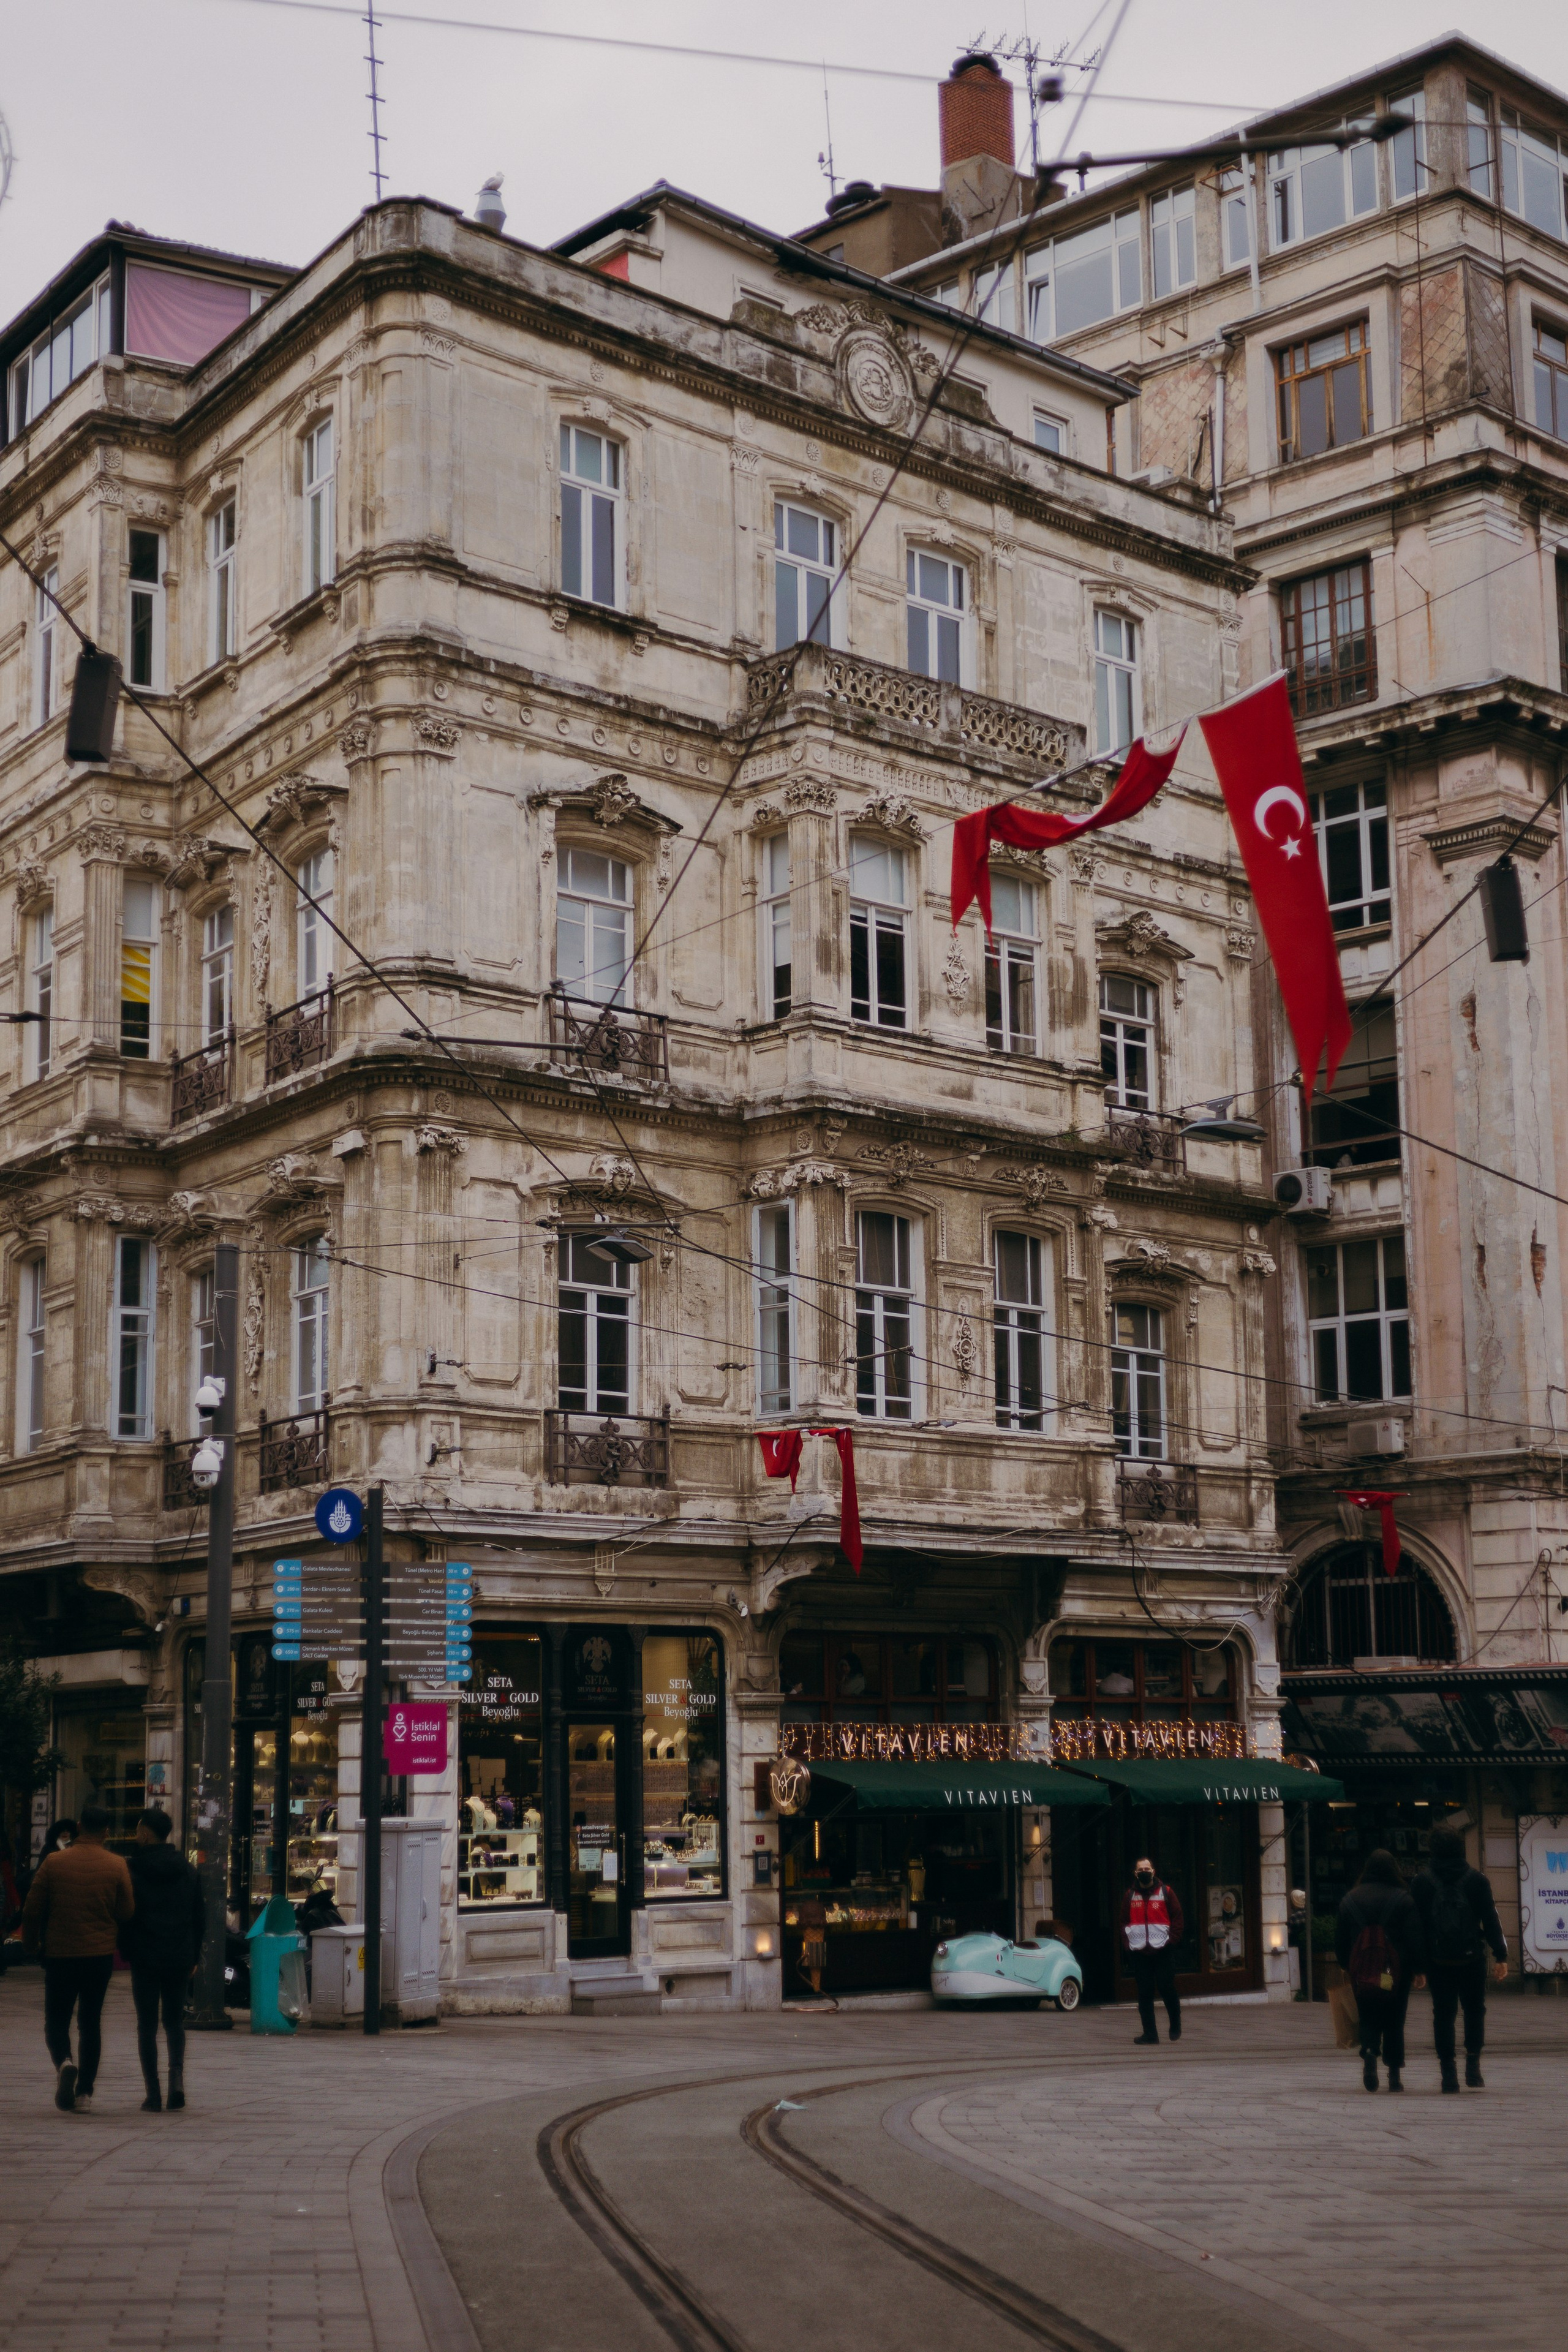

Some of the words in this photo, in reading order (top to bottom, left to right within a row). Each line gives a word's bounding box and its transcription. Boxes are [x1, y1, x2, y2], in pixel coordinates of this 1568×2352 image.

[488, 1677, 513, 1687] SETA
[585, 1675, 609, 1685] SETA
[669, 1679, 692, 1689] SETA
[311, 1681, 325, 1692] SETA
[297, 1697, 316, 1708] SILVER
[461, 1692, 497, 1703] SILVER
[510, 1692, 539, 1703] GOLD
[646, 1694, 678, 1704] SILVER
[680, 1694, 687, 1704] &
[689, 1694, 716, 1704] GOLD
[307, 1709, 328, 1724] Beyoğlu
[481, 1705, 519, 1720] Beyoğlu
[664, 1706, 698, 1720] Beyoğlu
[412, 1720, 440, 1731] İstiklal
[411, 1732, 436, 1741] Senin
[1102, 1730, 1211, 1748] VITAVIEN
[842, 1733, 967, 1753] VITAVIEN
[944, 1790, 1032, 1804] VITAVIEN
[1204, 1787, 1279, 1801] VITAVIEN
